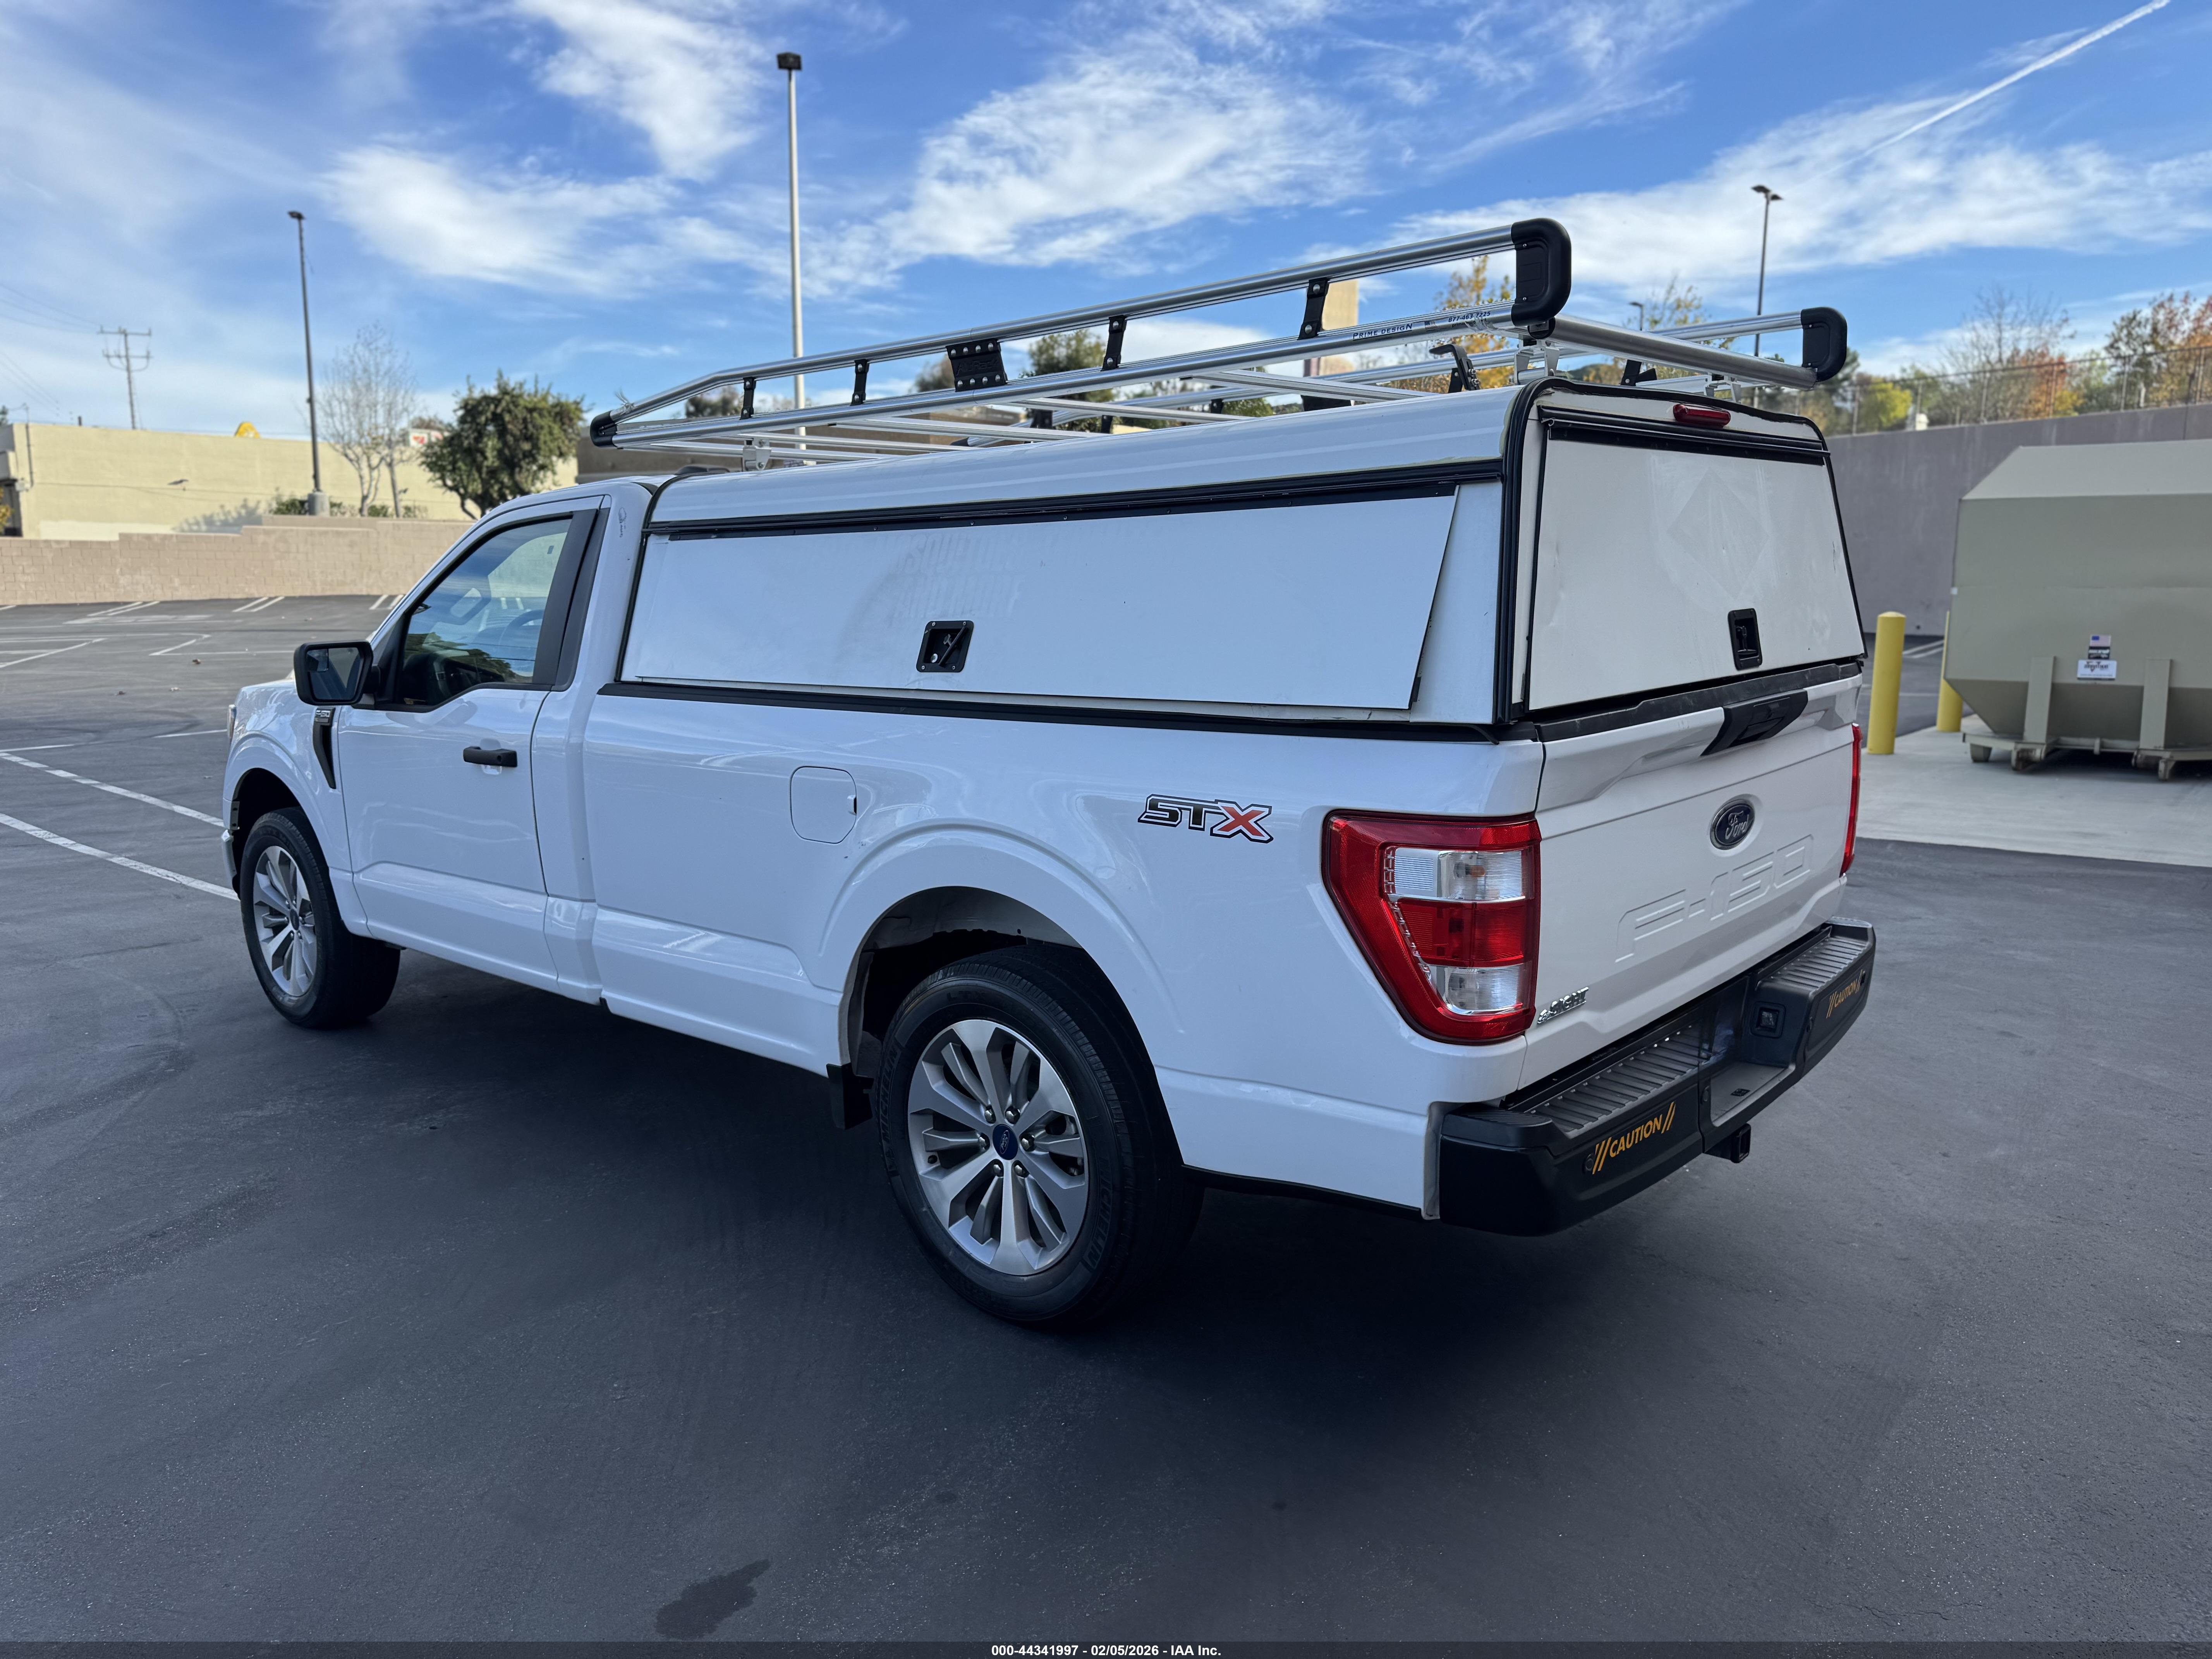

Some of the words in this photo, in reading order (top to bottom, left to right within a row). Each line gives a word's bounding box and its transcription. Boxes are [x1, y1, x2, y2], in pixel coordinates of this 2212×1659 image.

[1381, 323, 1413, 335] DESIGN
[1137, 793, 1274, 844] STX
[1615, 834, 1814, 963] F-150
[1609, 1114, 1663, 1158] CAUTION
